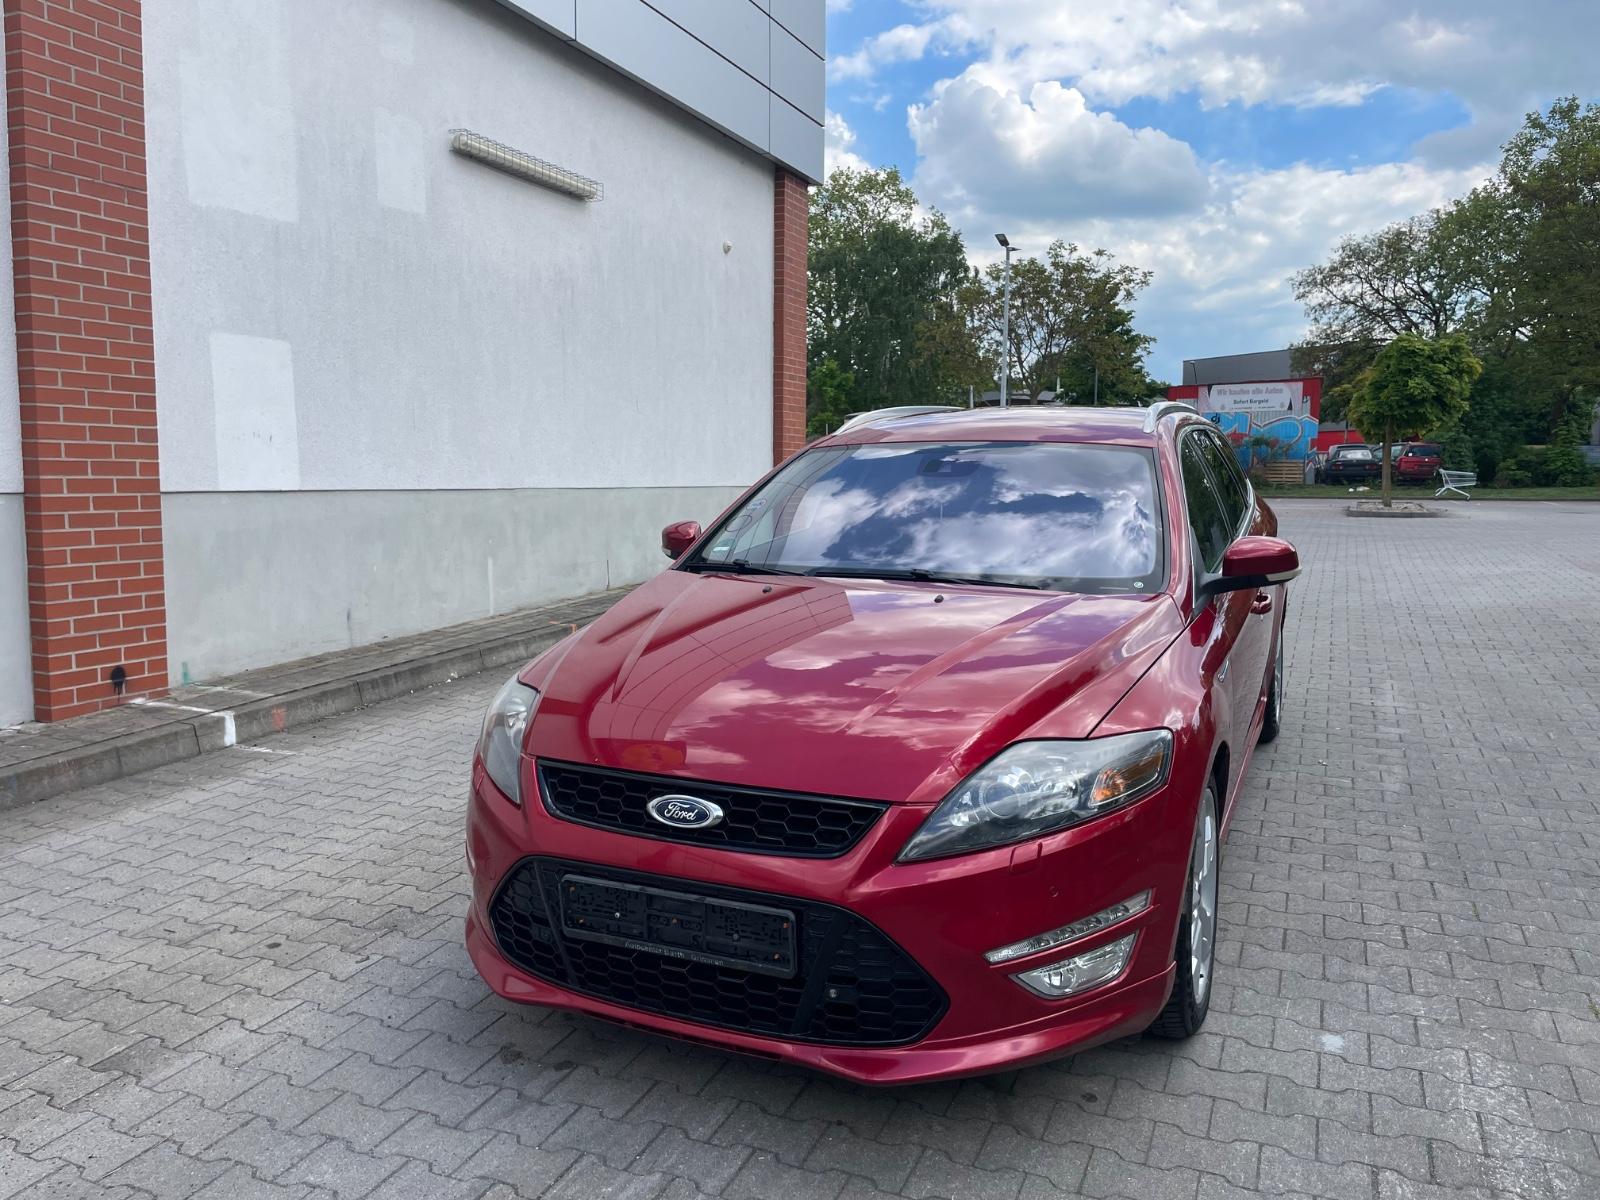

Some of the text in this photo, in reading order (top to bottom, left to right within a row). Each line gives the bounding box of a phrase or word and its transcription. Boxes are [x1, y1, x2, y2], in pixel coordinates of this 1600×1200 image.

[1217, 388, 1227, 396] Wir
[1252, 386, 1264, 394] alle
[664, 802, 699, 820] Ford
